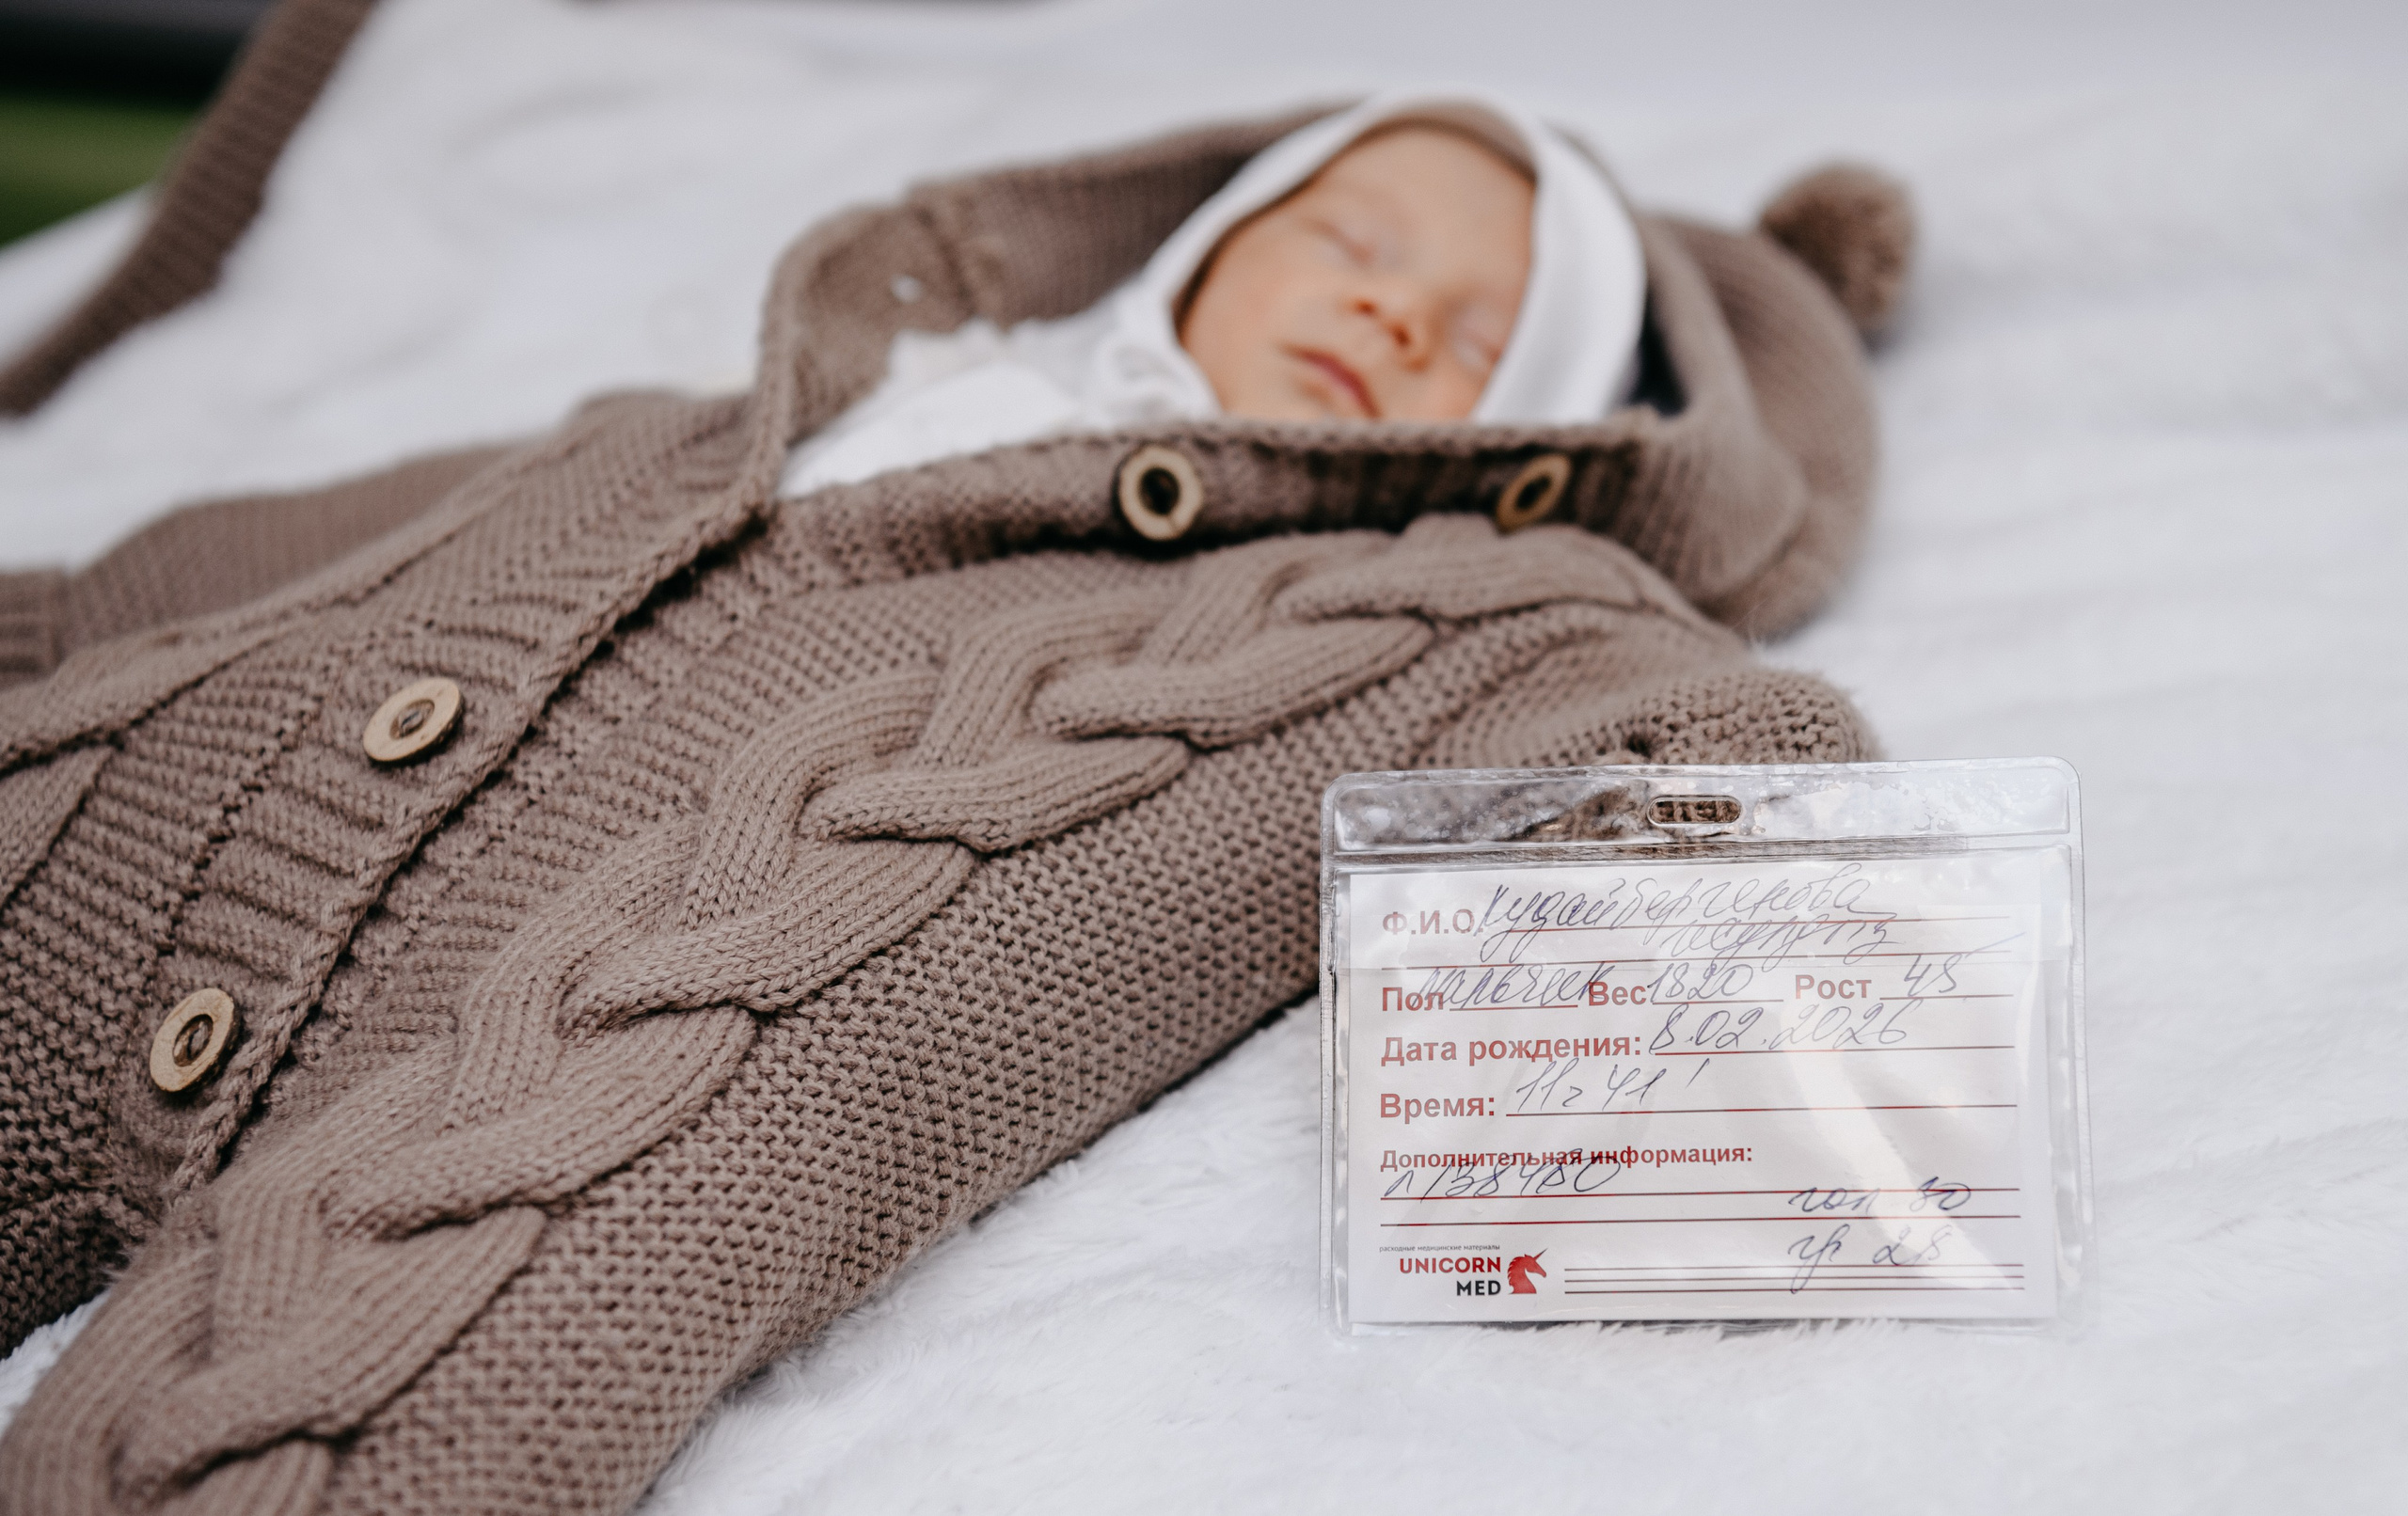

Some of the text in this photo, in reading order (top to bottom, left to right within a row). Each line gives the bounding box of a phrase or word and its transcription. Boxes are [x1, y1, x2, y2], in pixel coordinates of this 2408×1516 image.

[1382, 987, 1444, 1011] Пол
[1589, 981, 1647, 1006] Вес
[1795, 973, 1873, 1000] Рост
[1381, 1035, 1641, 1066] Дата рождения:
[1379, 1094, 1495, 1125] Время:
[1380, 1145, 1753, 1173] Дополнительная информация:
[1399, 1256, 1502, 1274] UNICORN
[1456, 1280, 1502, 1297] MED
